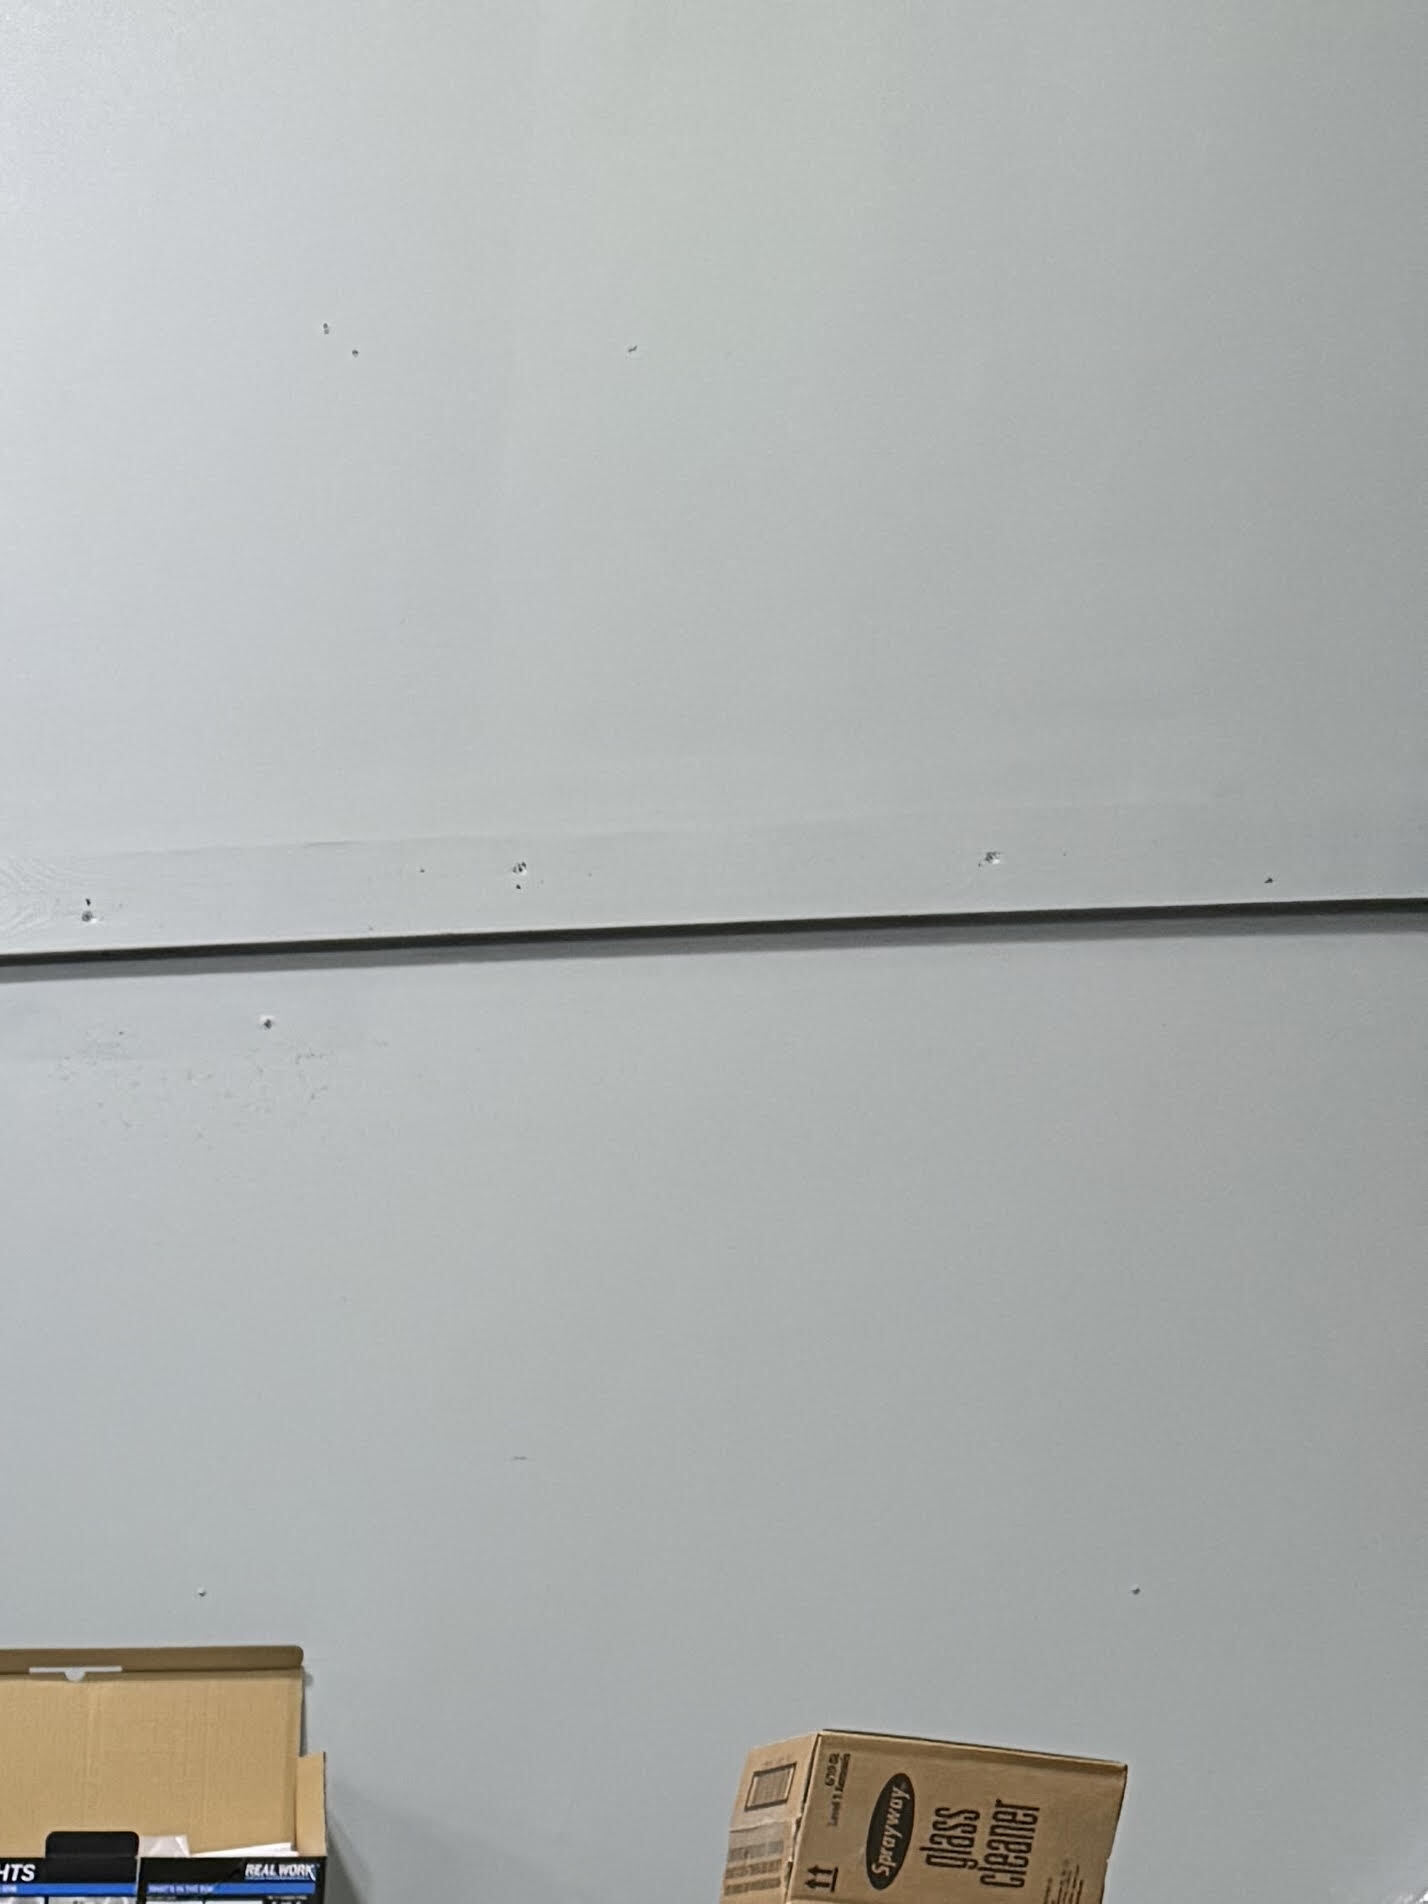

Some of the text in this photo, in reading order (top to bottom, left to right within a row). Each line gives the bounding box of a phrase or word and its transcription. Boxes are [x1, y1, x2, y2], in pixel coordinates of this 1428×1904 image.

[871, 1785, 911, 1878] Sprayway
[919, 1807, 981, 1870] glass
[976, 1799, 1041, 1889] cleaner
[245, 1864, 316, 1881] REAL WORK
